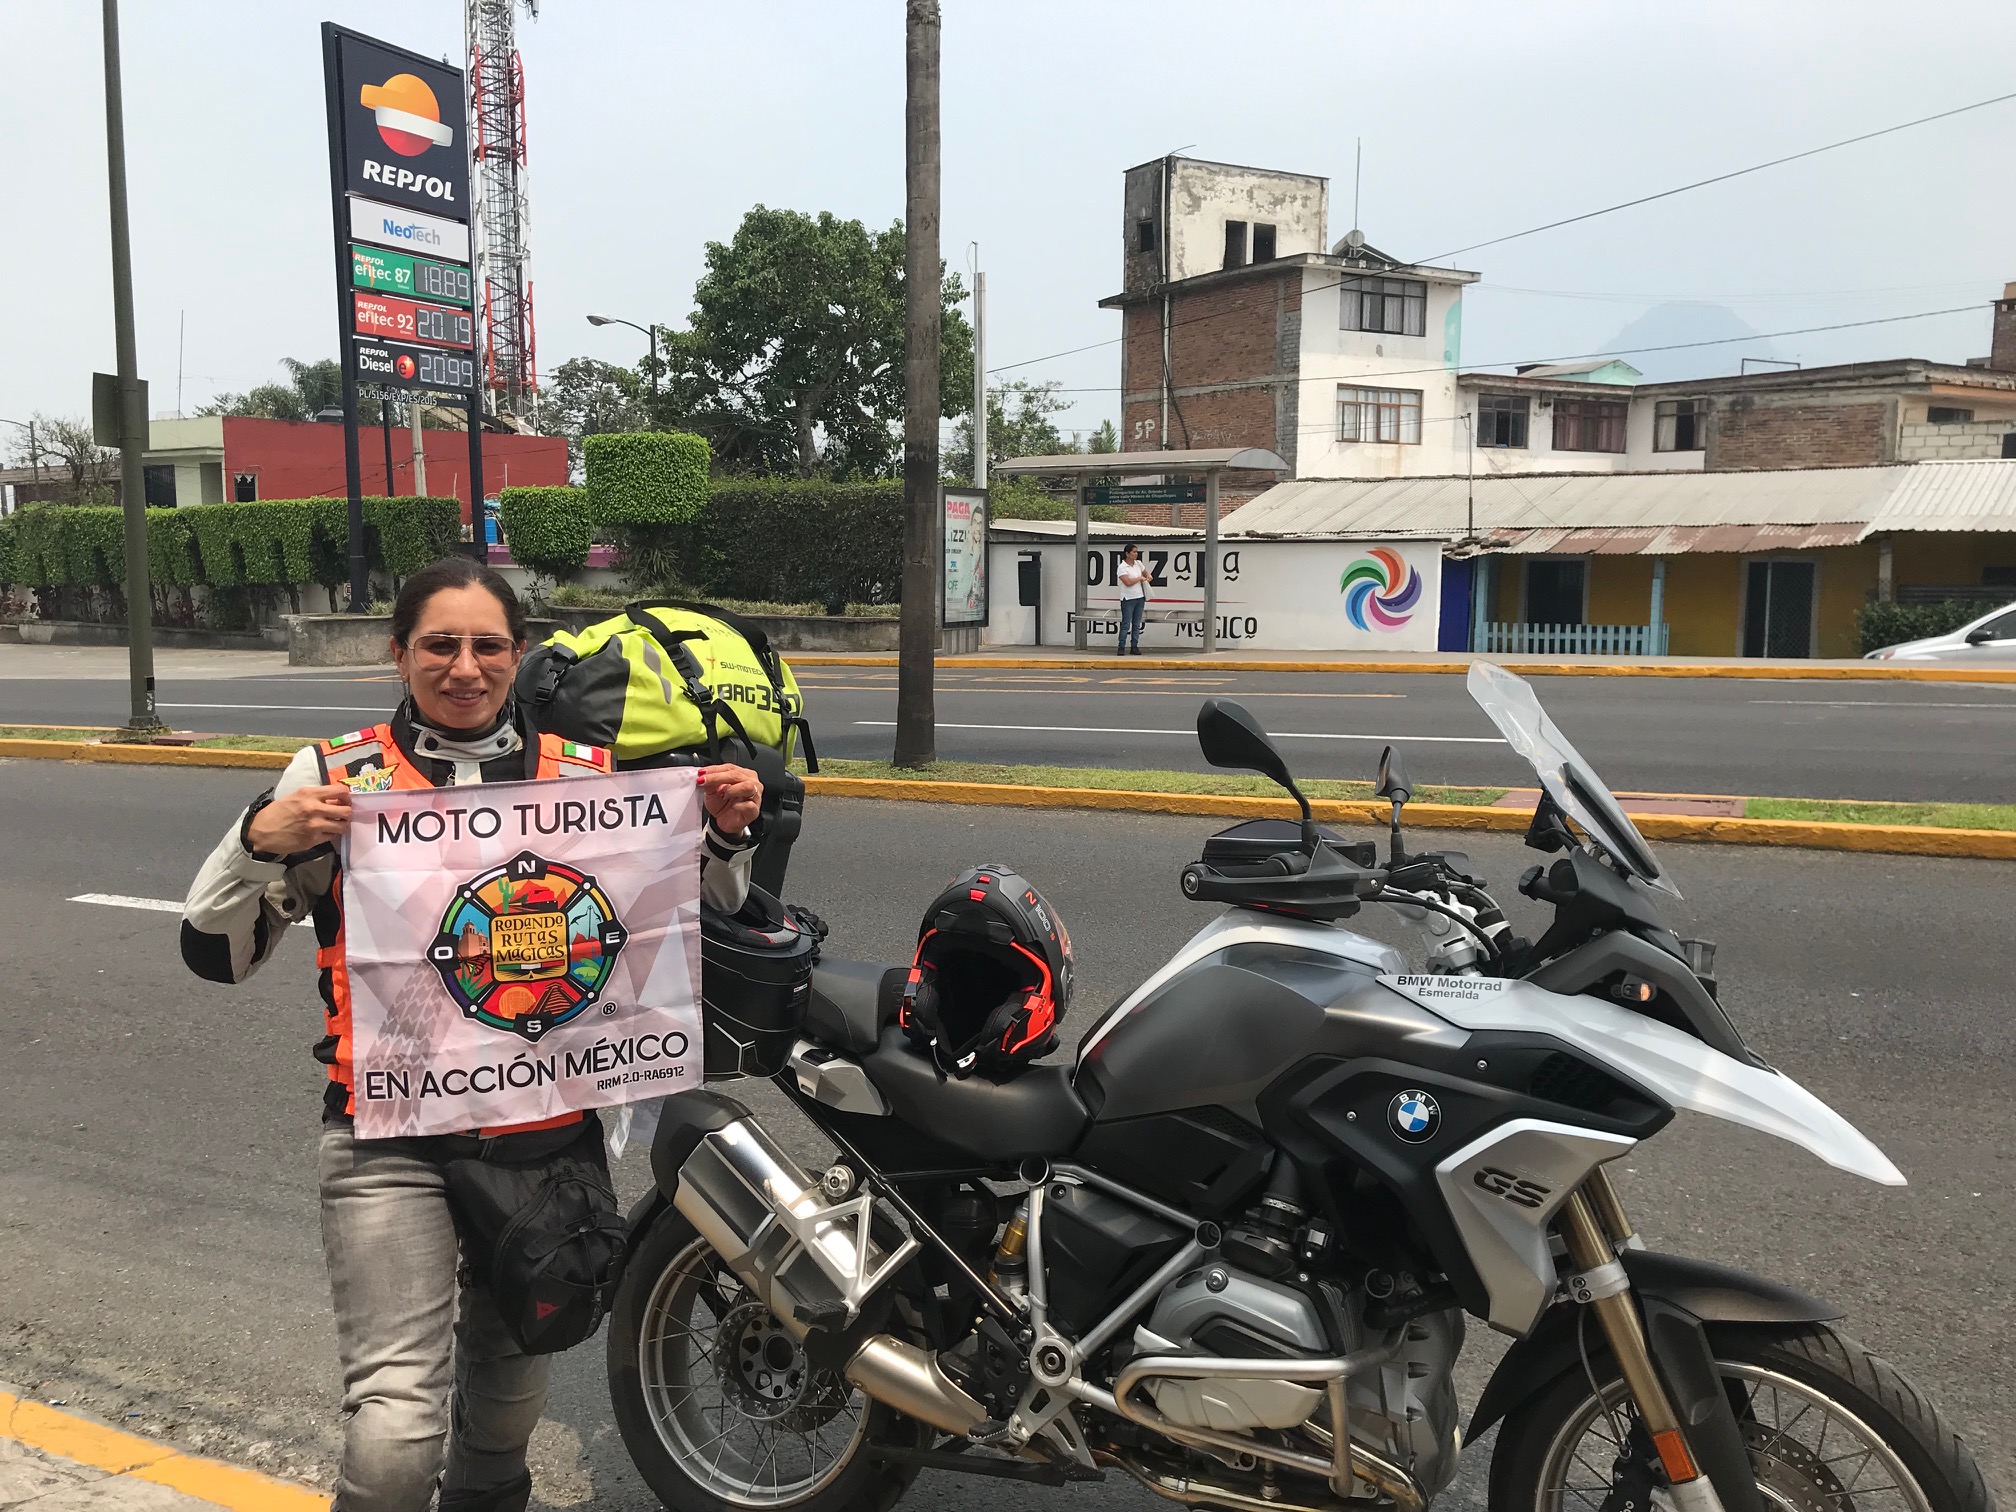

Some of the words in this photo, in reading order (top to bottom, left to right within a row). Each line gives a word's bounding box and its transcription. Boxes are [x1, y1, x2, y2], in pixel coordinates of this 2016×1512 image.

[363, 159, 455, 202] REPSOL
[383, 218, 441, 245] NeoTech
[354, 254, 384, 266] REPSOL
[355, 264, 392, 281] efitec
[394, 267, 411, 284] 87
[424, 266, 469, 300] 18.89
[357, 301, 387, 312] REPSOL
[358, 311, 395, 327] efitec
[397, 313, 414, 330] 92
[418, 309, 471, 344] 20.19
[359, 347, 389, 358] REPSOL
[359, 355, 394, 373] Diesel
[420, 354, 474, 387] 20.99
[947, 501, 971, 515] PAGA
[377, 806, 502, 845] MOTO
[513, 794, 668, 837] TURISTA
[517, 859, 536, 874] N
[605, 931, 620, 944] E
[434, 946, 453, 960] O
[1397, 976, 1433, 987] BMW
[1437, 977, 1502, 992] Motorrad
[1418, 988, 1479, 1000] Esmeralda
[526, 1019, 542, 1033] S
[366, 1071, 410, 1101] EN
[419, 1052, 557, 1098] ACCIÓN
[565, 1031, 689, 1078] MÉXICO
[596, 1075, 622, 1091] RRM
[622, 1065, 685, 1086] 2.0-RA6912
[1399, 1093, 1439, 1116] BMW
[1473, 1166, 1552, 1209] GS
